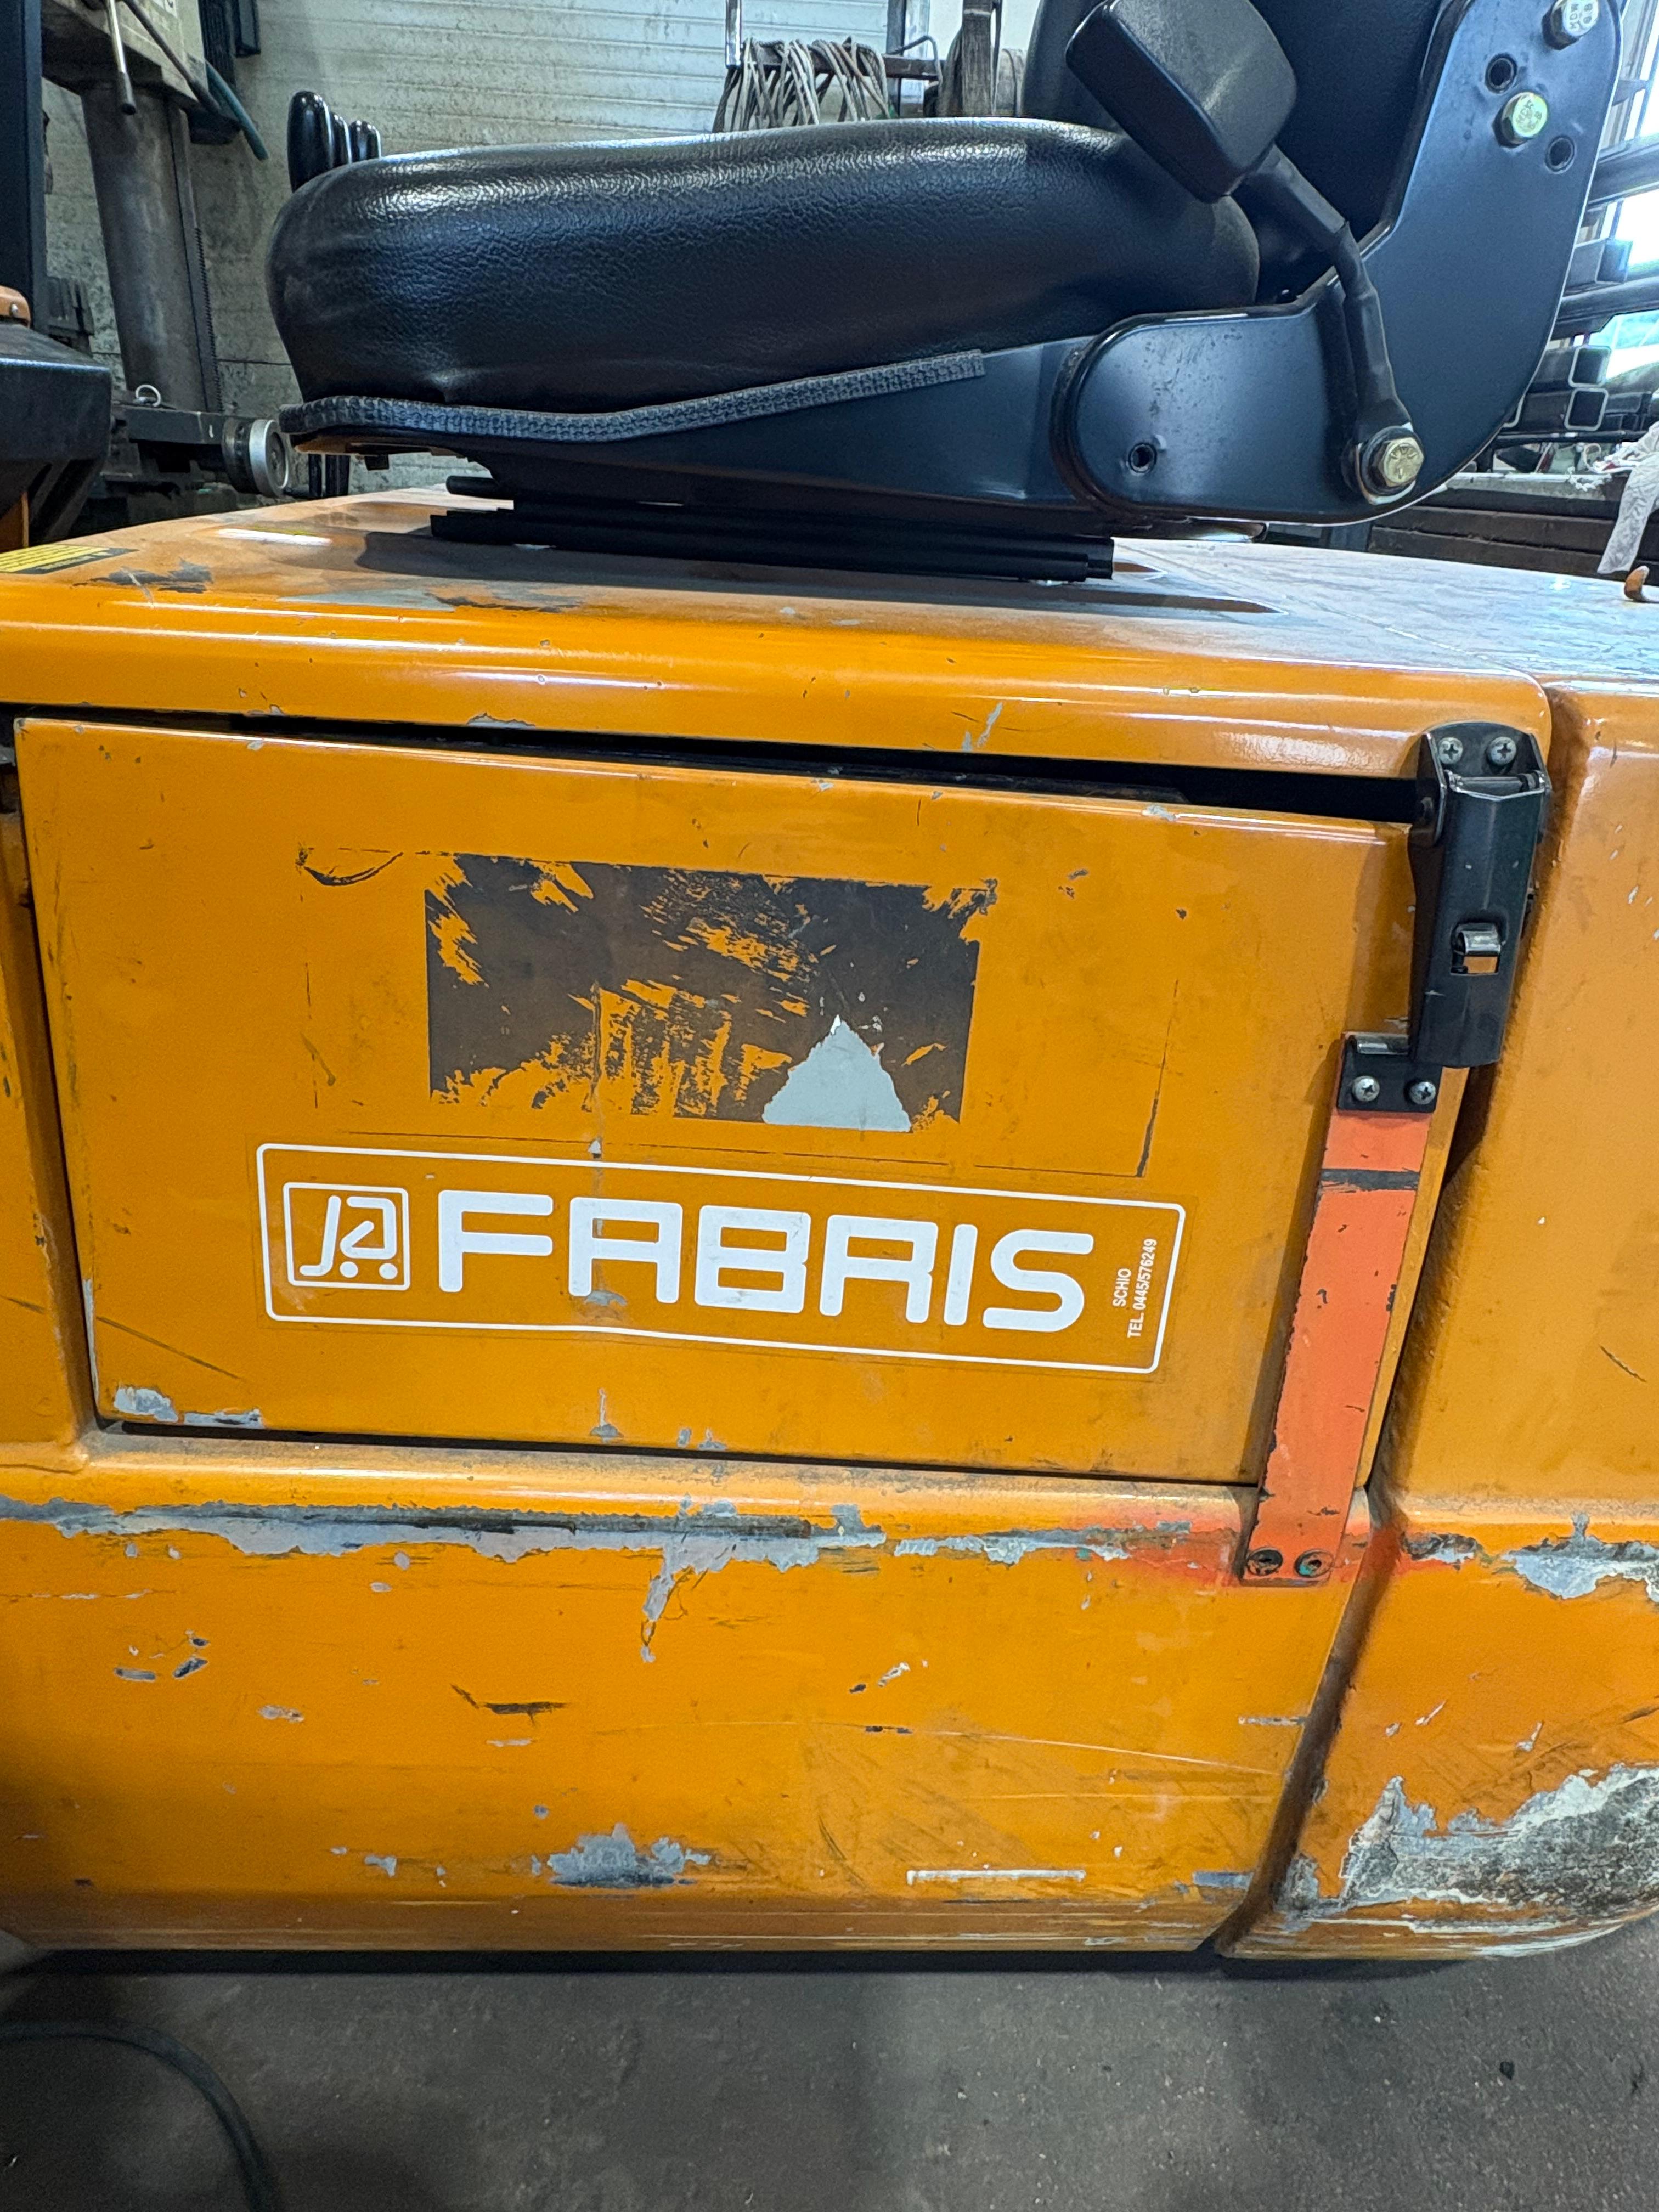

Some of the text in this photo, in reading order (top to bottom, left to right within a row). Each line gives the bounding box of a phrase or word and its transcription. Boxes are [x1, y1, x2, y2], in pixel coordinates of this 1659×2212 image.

[438, 1189, 1094, 1332] FABRIS
[1113, 1268, 1131, 1307] SCHIO
[1127, 1238, 1158, 1338] TEL. 0445/576249
